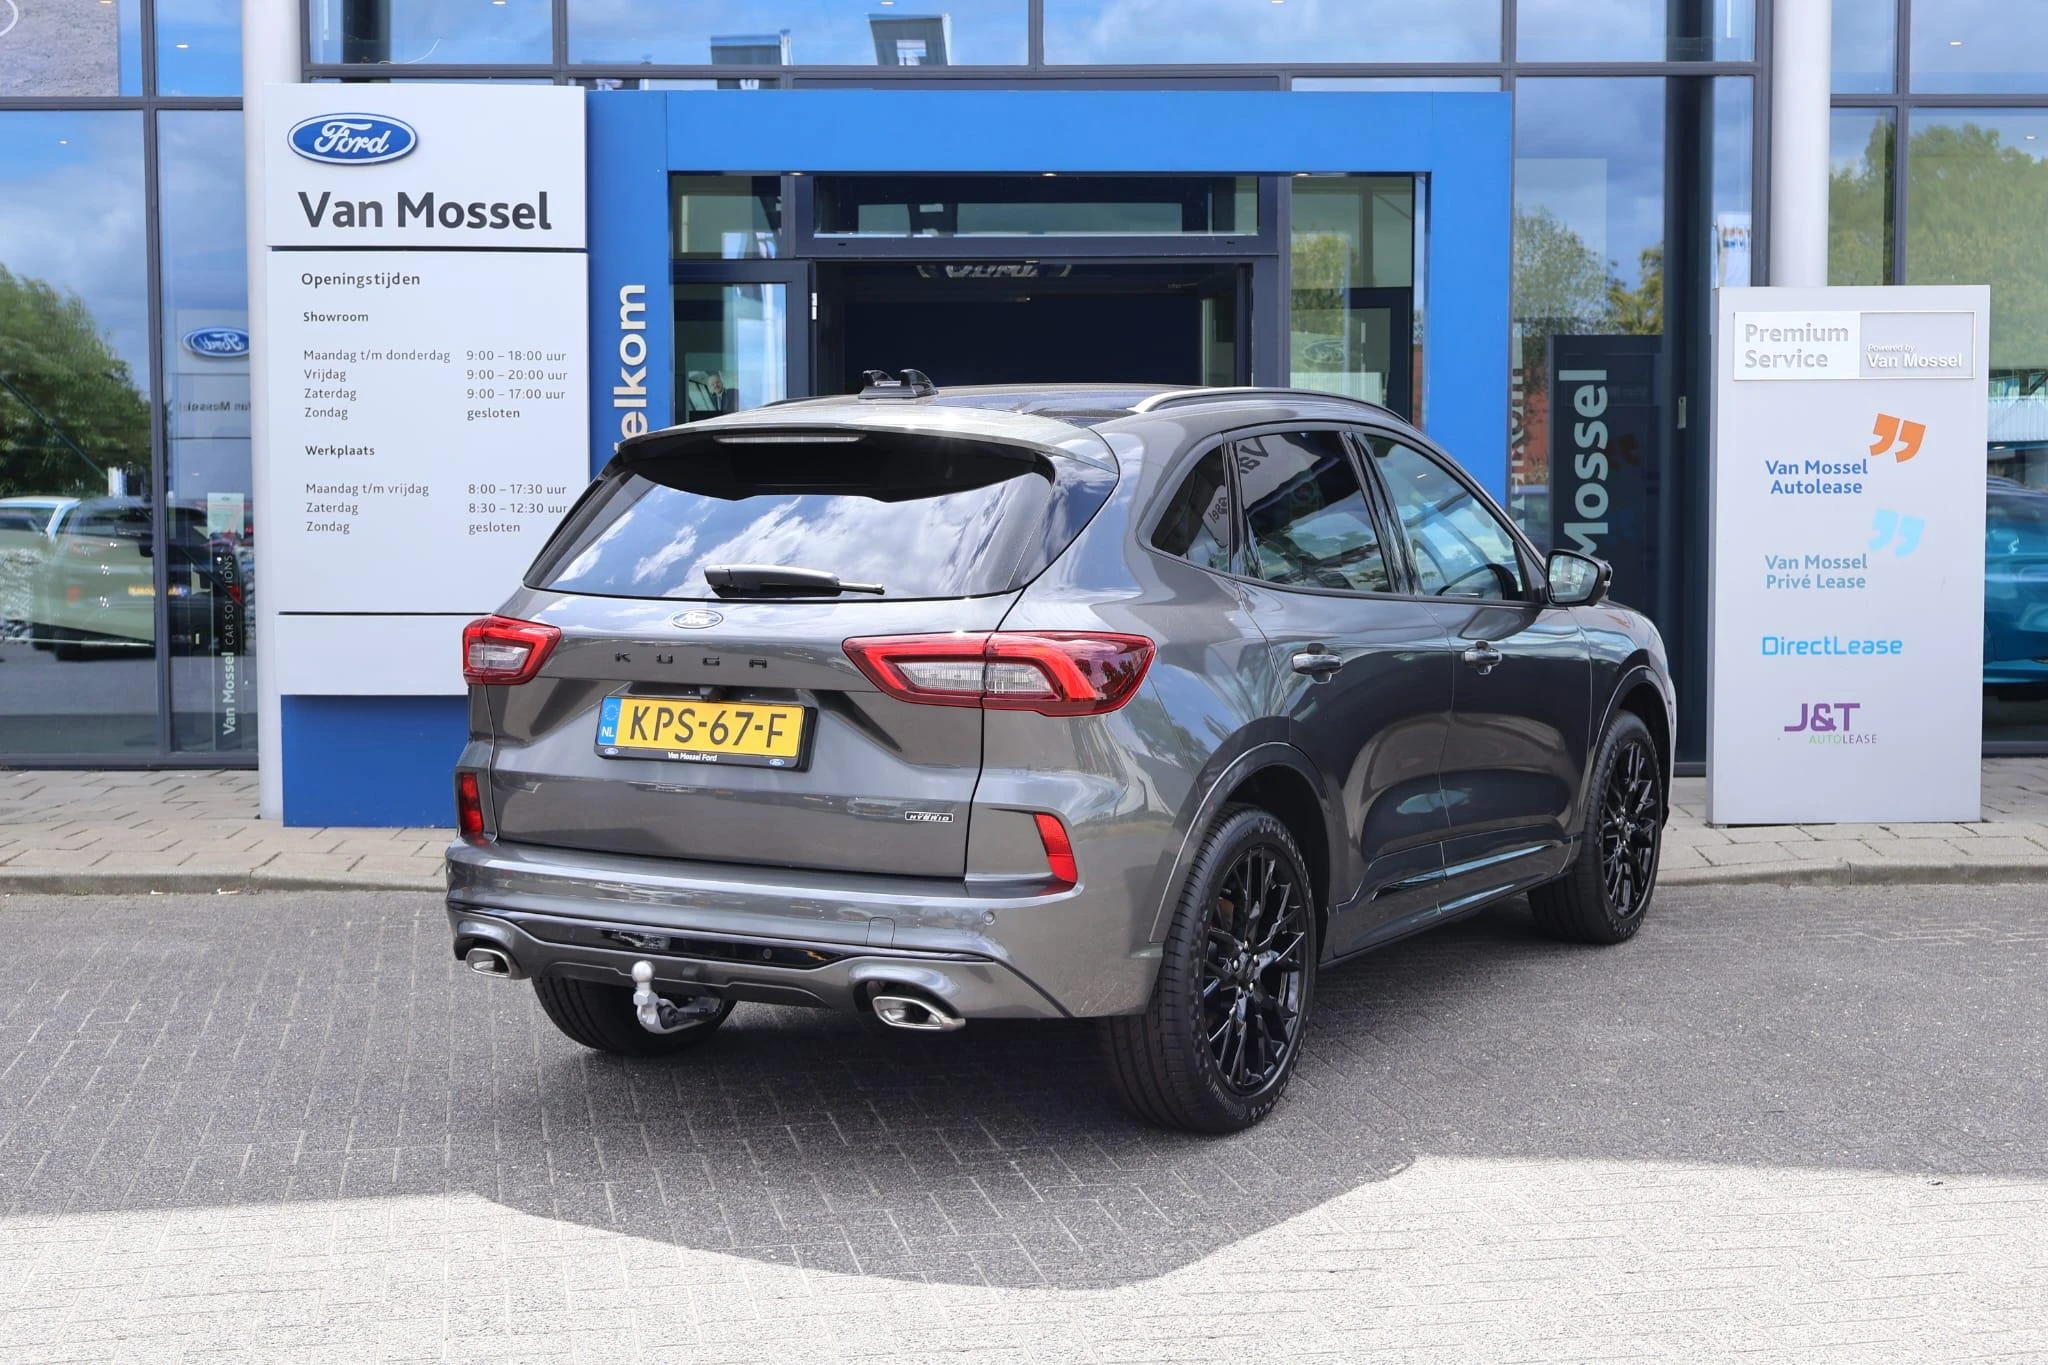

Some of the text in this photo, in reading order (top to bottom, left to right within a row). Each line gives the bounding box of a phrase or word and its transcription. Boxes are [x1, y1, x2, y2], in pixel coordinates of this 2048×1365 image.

[314, 121, 391, 154] Ford
[298, 191, 552, 230] Van Mossel
[302, 272, 420, 288] Openingstijden
[304, 312, 368, 321] Showroom
[1746, 323, 1848, 342] Premium
[1867, 343, 1915, 352] Powered by
[304, 349, 450, 363] Maandag t/m donderdag
[467, 351, 493, 360] 9:00
[508, 351, 542, 360] 18:00
[1744, 349, 1828, 368] Service
[1866, 352, 1963, 368] Van Mossel
[304, 369, 346, 382] Vrijdag
[467, 370, 494, 380] 9:00
[508, 370, 543, 380] 20:00
[614, 284, 648, 453] elkom
[305, 388, 356, 401] Zaterdag
[467, 389, 494, 399] 9:00
[509, 389, 541, 399] 17:00
[305, 407, 348, 420] Zondag
[467, 408, 520, 421] gesloten
[305, 445, 374, 458] Werkplaats
[1765, 459, 1868, 474] Van Mossel
[306, 483, 429, 497] Maandag t/m vrijdag
[469, 484, 495, 494] 8:00
[510, 484, 542, 494] 17:30
[1771, 479, 1862, 494] Autolease
[307, 502, 358, 515] Zaterdag
[469, 503, 495, 513] 8:30
[510, 503, 543, 513] 12:30
[549, 506, 568, 514] uur
[307, 521, 350, 534] Zondag
[469, 521, 520, 535] gesloten
[1764, 553, 1867, 569] Van Mossel
[1765, 574, 1865, 589] Privé Lease
[225, 625, 235, 647] CAR
[1760, 635, 1903, 656] DirectLease
[615, 652, 767, 668] KUGA
[221, 651, 236, 703] Mossel
[223, 706, 235, 736] Van
[1784, 703, 1860, 732] J&T
[602, 727, 615, 737] NL
[629, 705, 787, 748] KPS-67-F
[1809, 734, 1877, 744] AUTOLEASE
[667, 751, 718, 762] Van Mossel Ford
